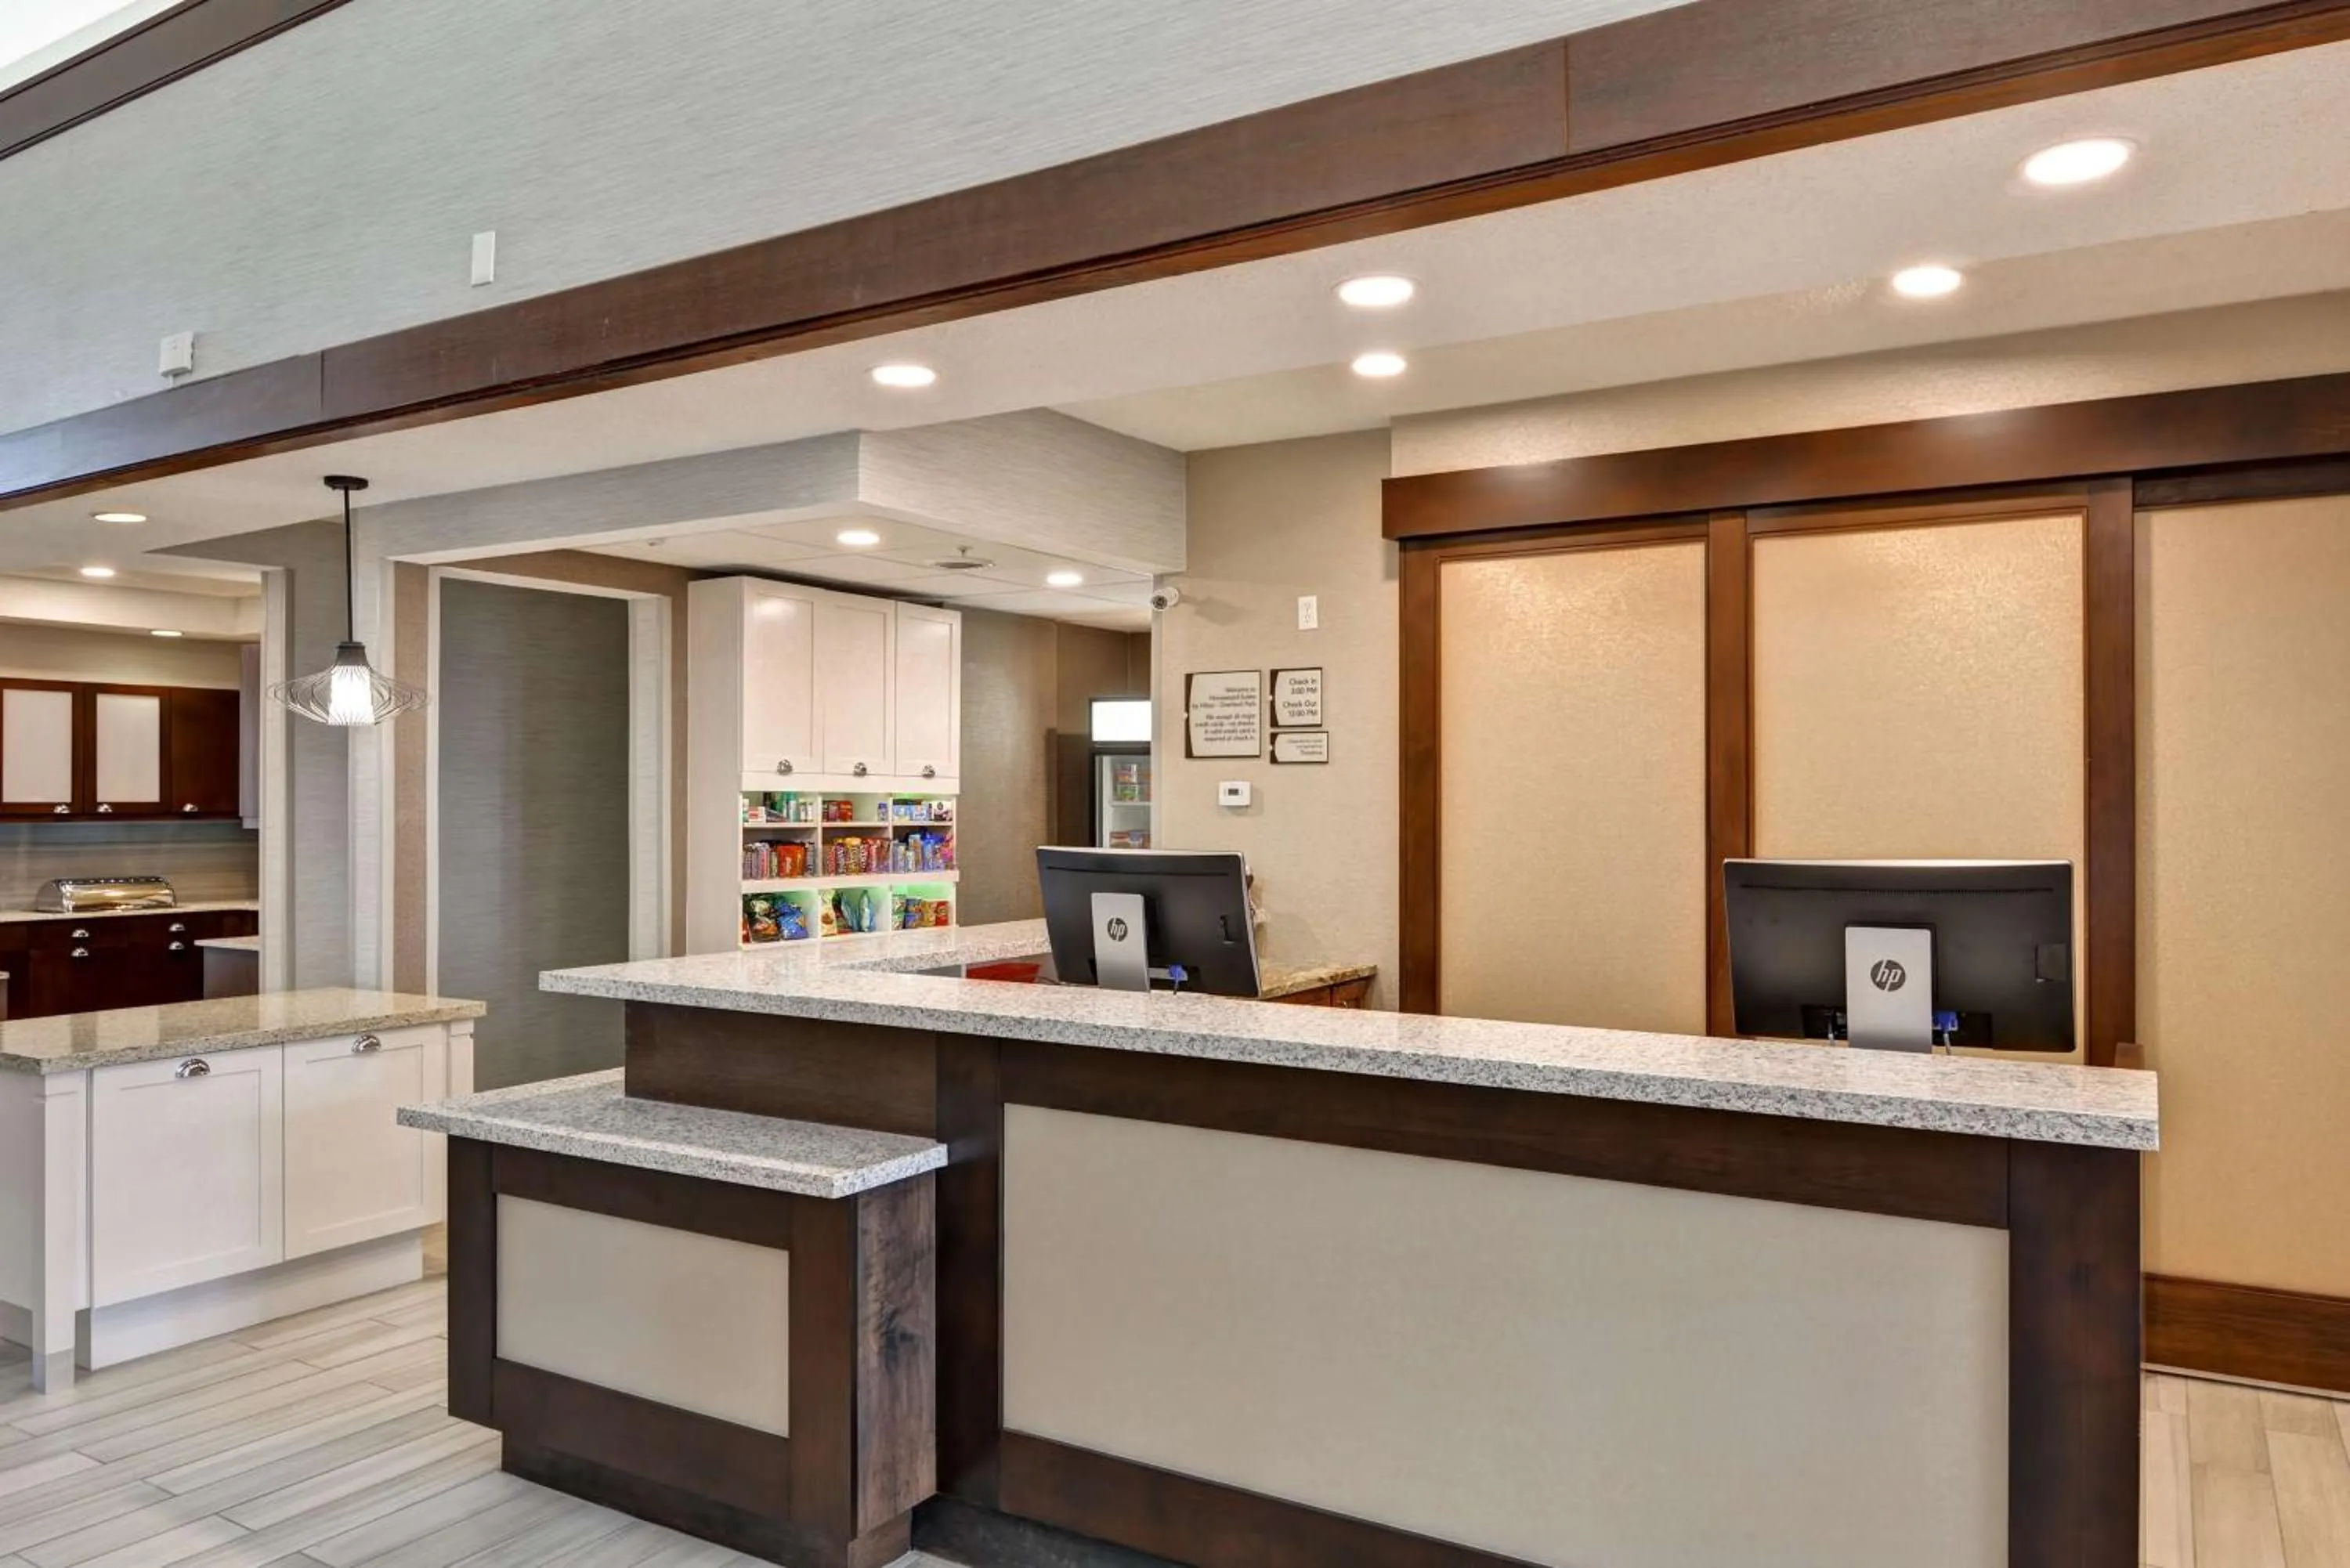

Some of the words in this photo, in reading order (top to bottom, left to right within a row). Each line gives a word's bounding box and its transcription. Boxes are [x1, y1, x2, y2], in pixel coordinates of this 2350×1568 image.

[1282, 700, 1303, 709] Check
[1304, 699, 1317, 707] Out
[1108, 917, 1126, 942] hp
[1872, 959, 1904, 992] hp
